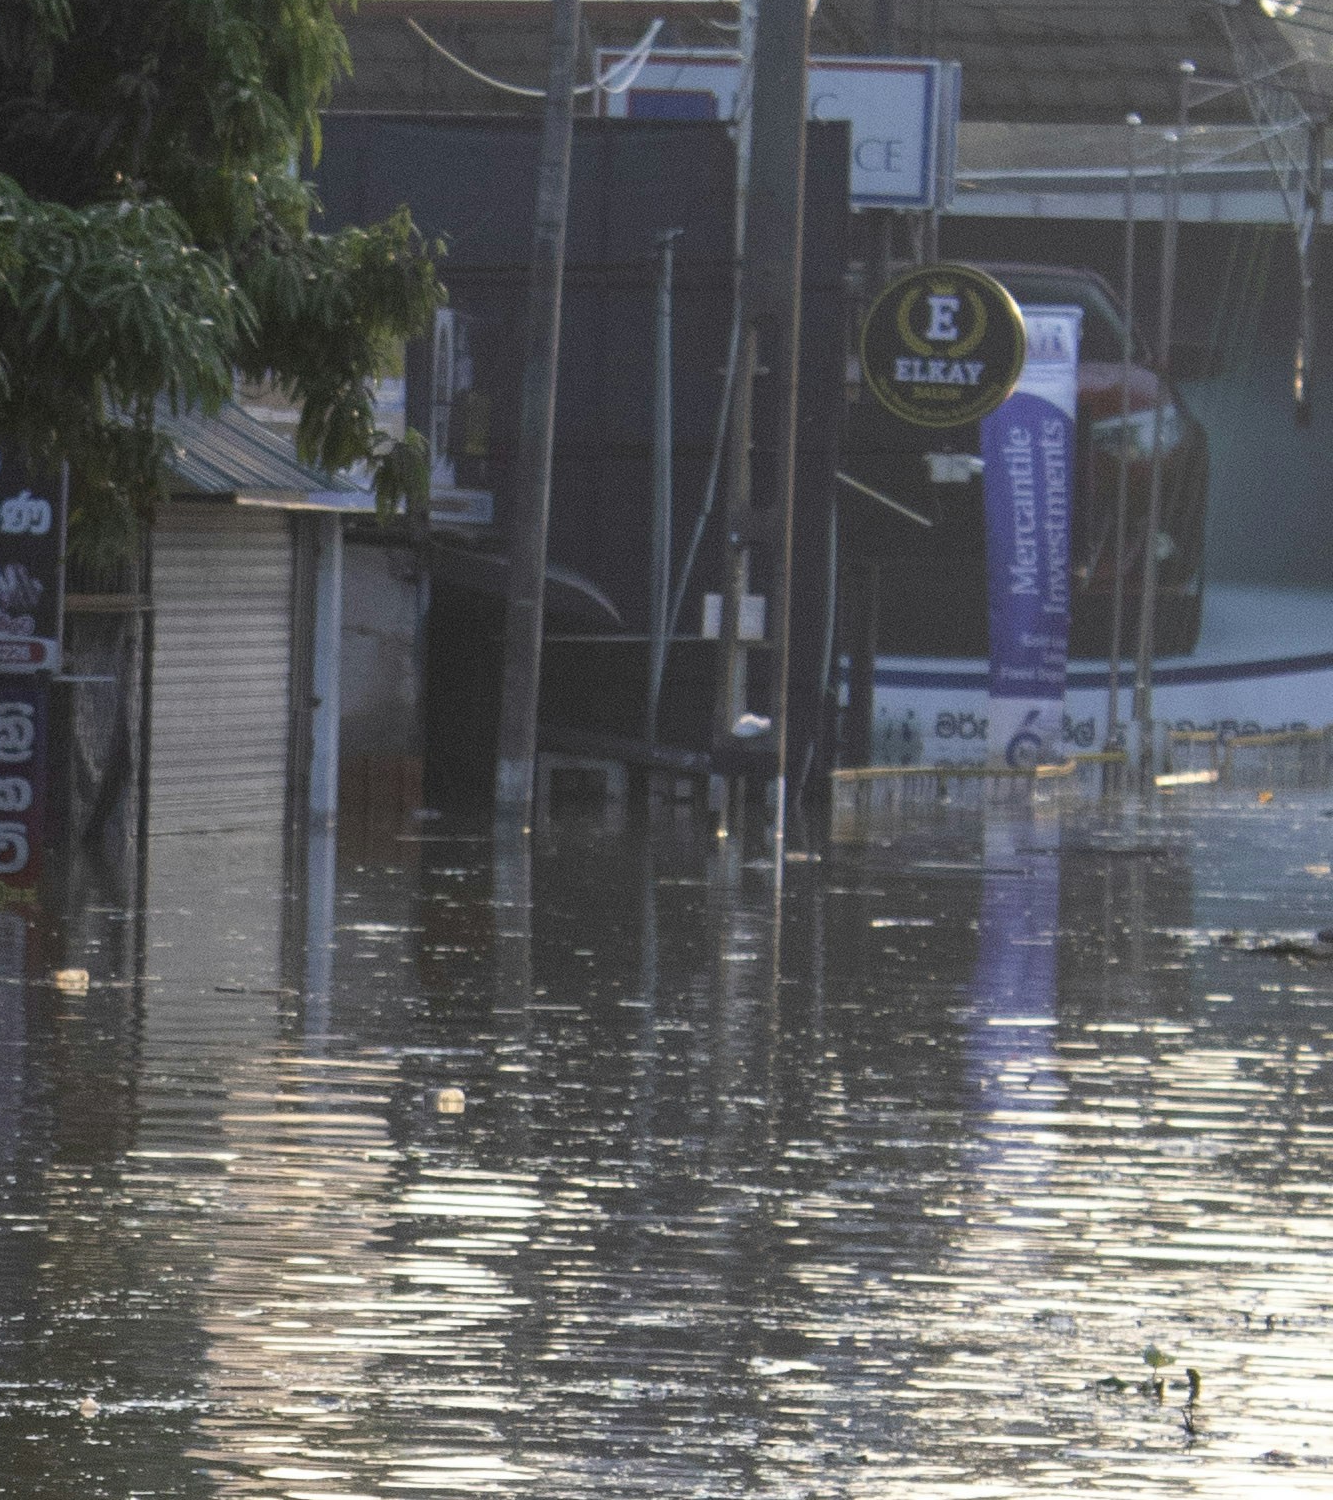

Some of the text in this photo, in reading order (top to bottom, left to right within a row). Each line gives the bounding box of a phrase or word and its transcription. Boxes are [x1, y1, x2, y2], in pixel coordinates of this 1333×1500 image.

[894, 357, 986, 386] ELKAY
[925, 295, 960, 341] E
[1001, 424, 1040, 597] Mercantile
[1039, 417, 1069, 615] Investments
